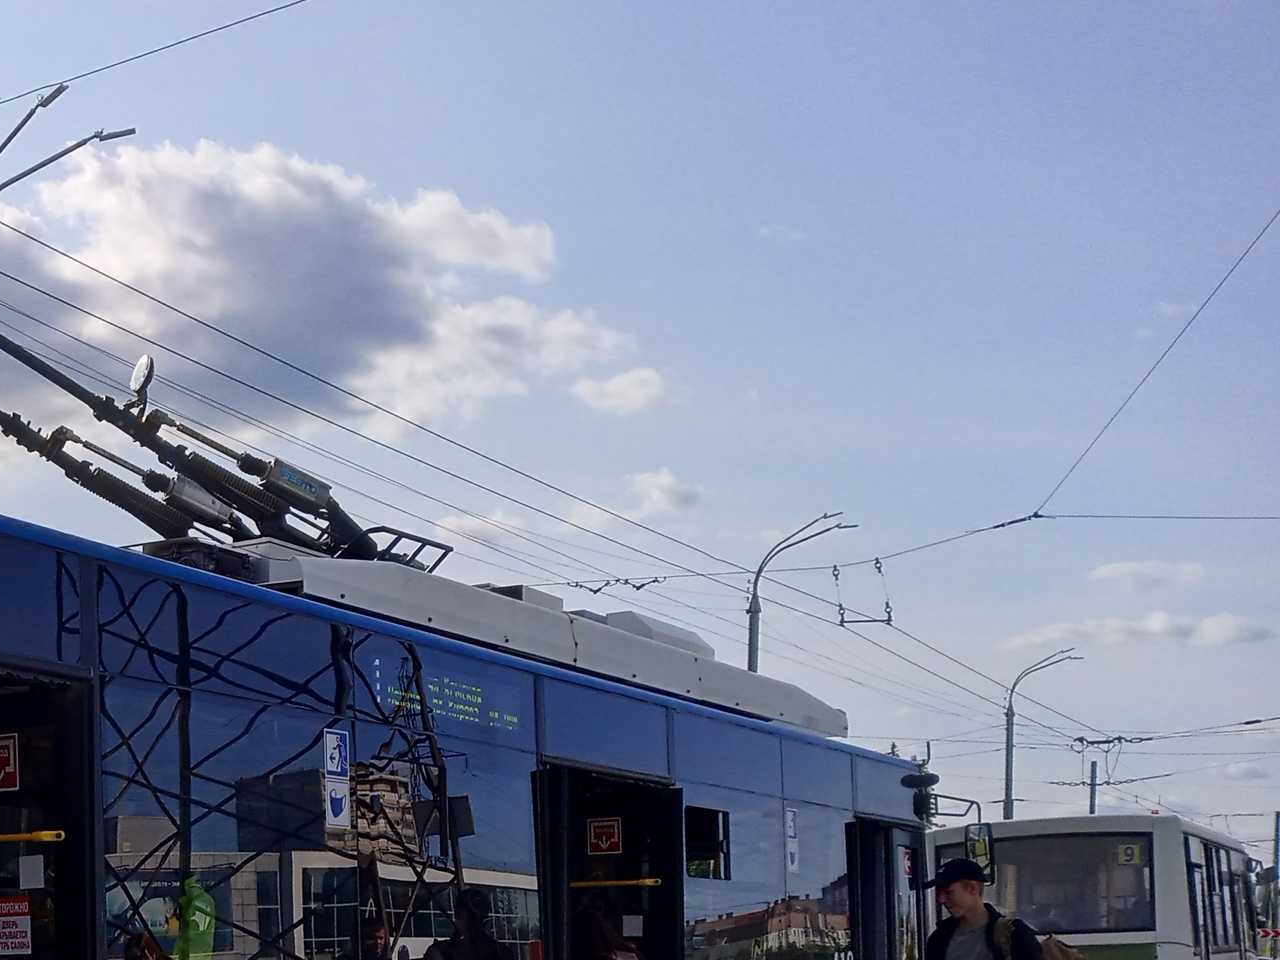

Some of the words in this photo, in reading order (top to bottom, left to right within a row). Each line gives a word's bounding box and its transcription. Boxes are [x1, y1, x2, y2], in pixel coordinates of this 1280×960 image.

[1124, 846, 1135, 863] 9
[1, 920, 19, 930] ДВЕРЬ
[10, 941, 30, 950] САЛОНА
